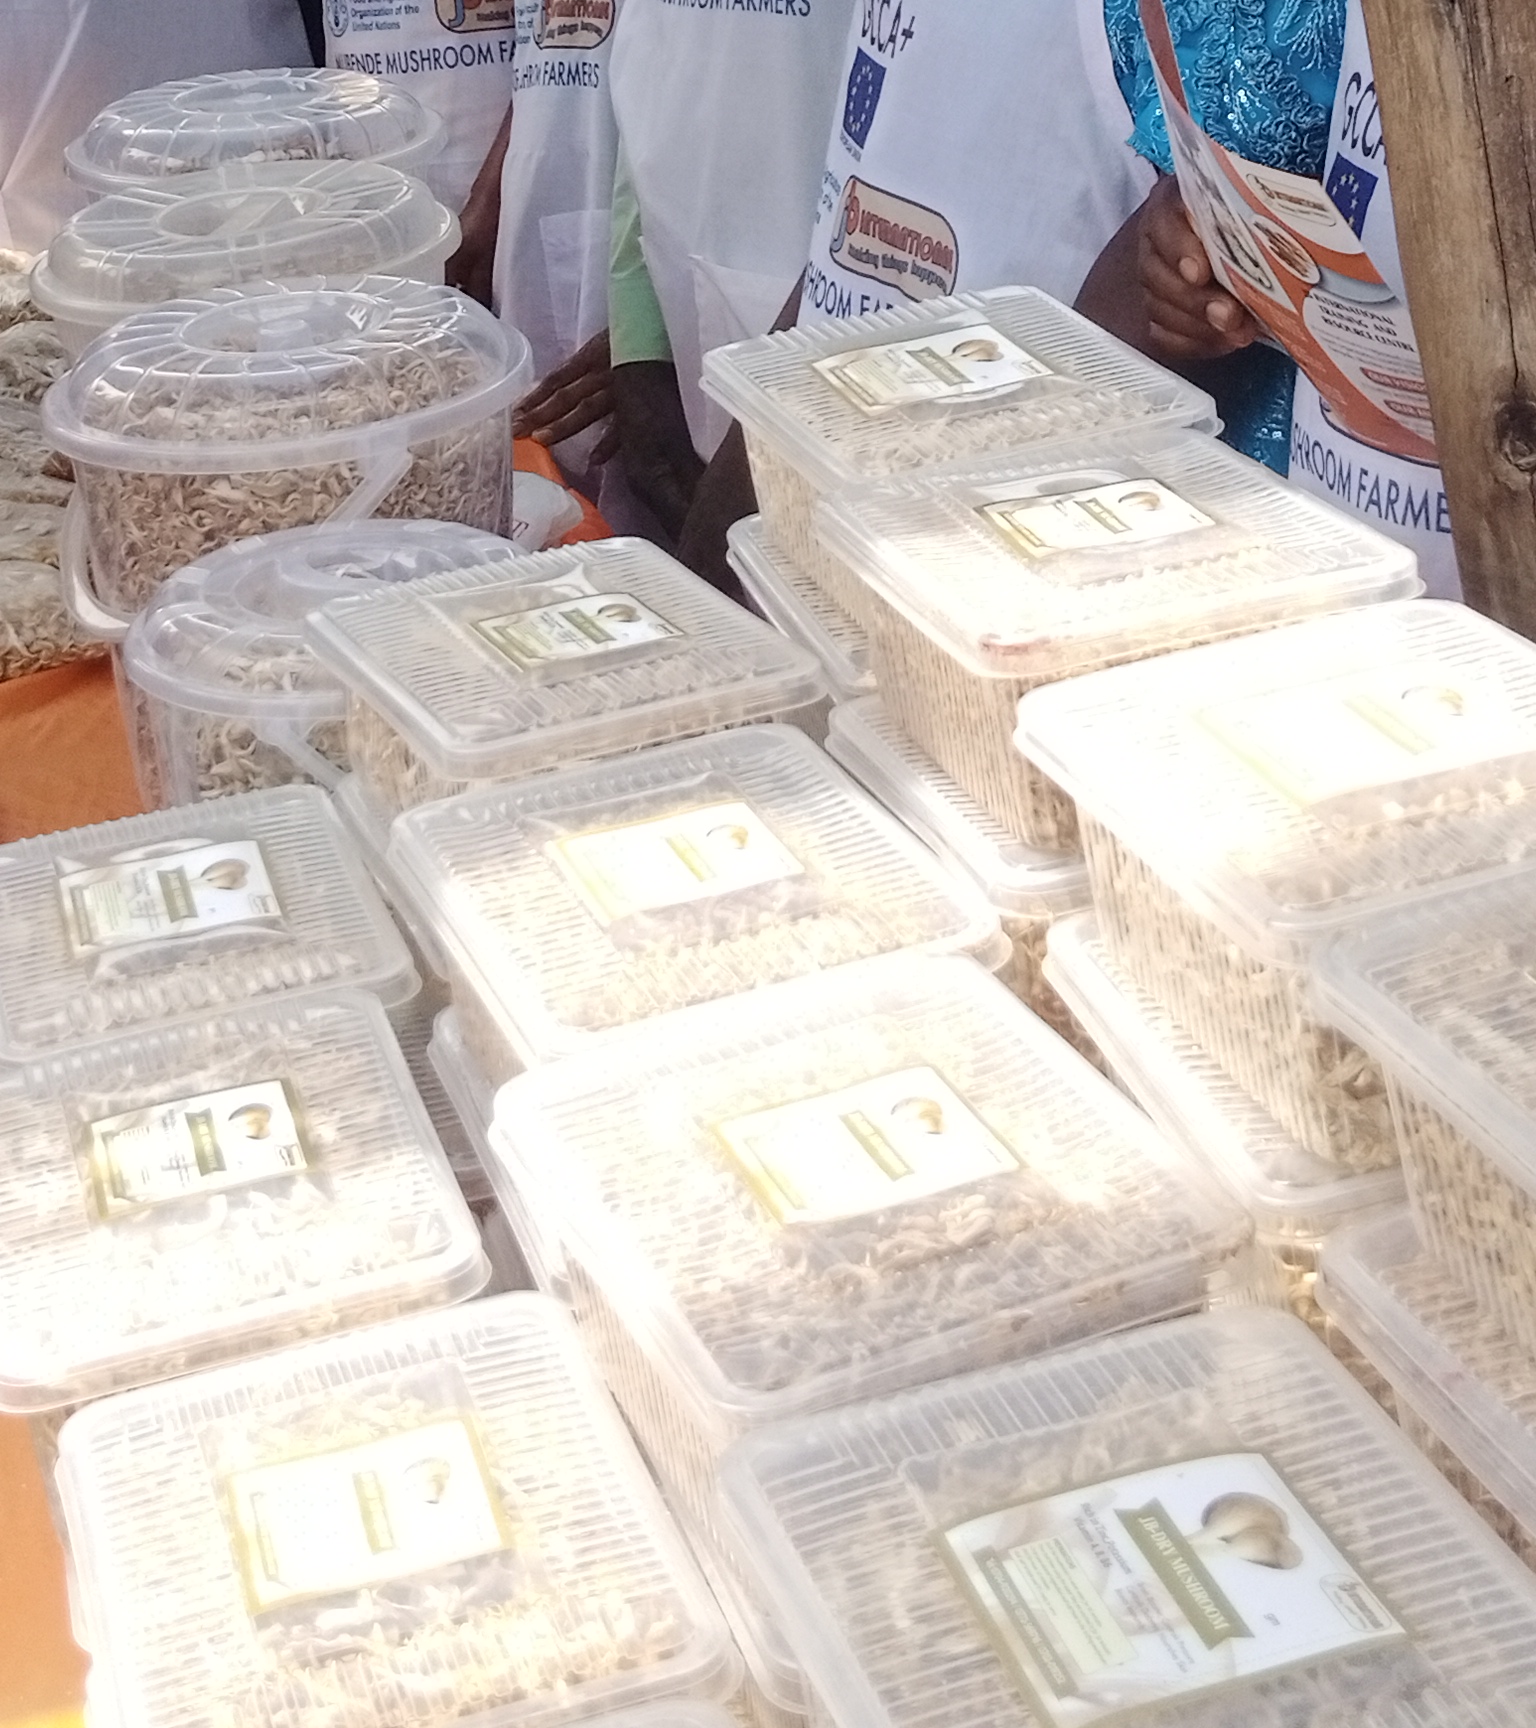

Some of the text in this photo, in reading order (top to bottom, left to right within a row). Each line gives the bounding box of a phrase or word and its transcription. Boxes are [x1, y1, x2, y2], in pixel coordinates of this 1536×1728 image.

[404, 4, 420, 14] the
[386, 43, 494, 75] MUSHROOM
[543, 61, 600, 88] FARMERS
[1138, 1516, 1173, 1556] JB-DRY
[1168, 1552, 1231, 1630] MUSHROOM
